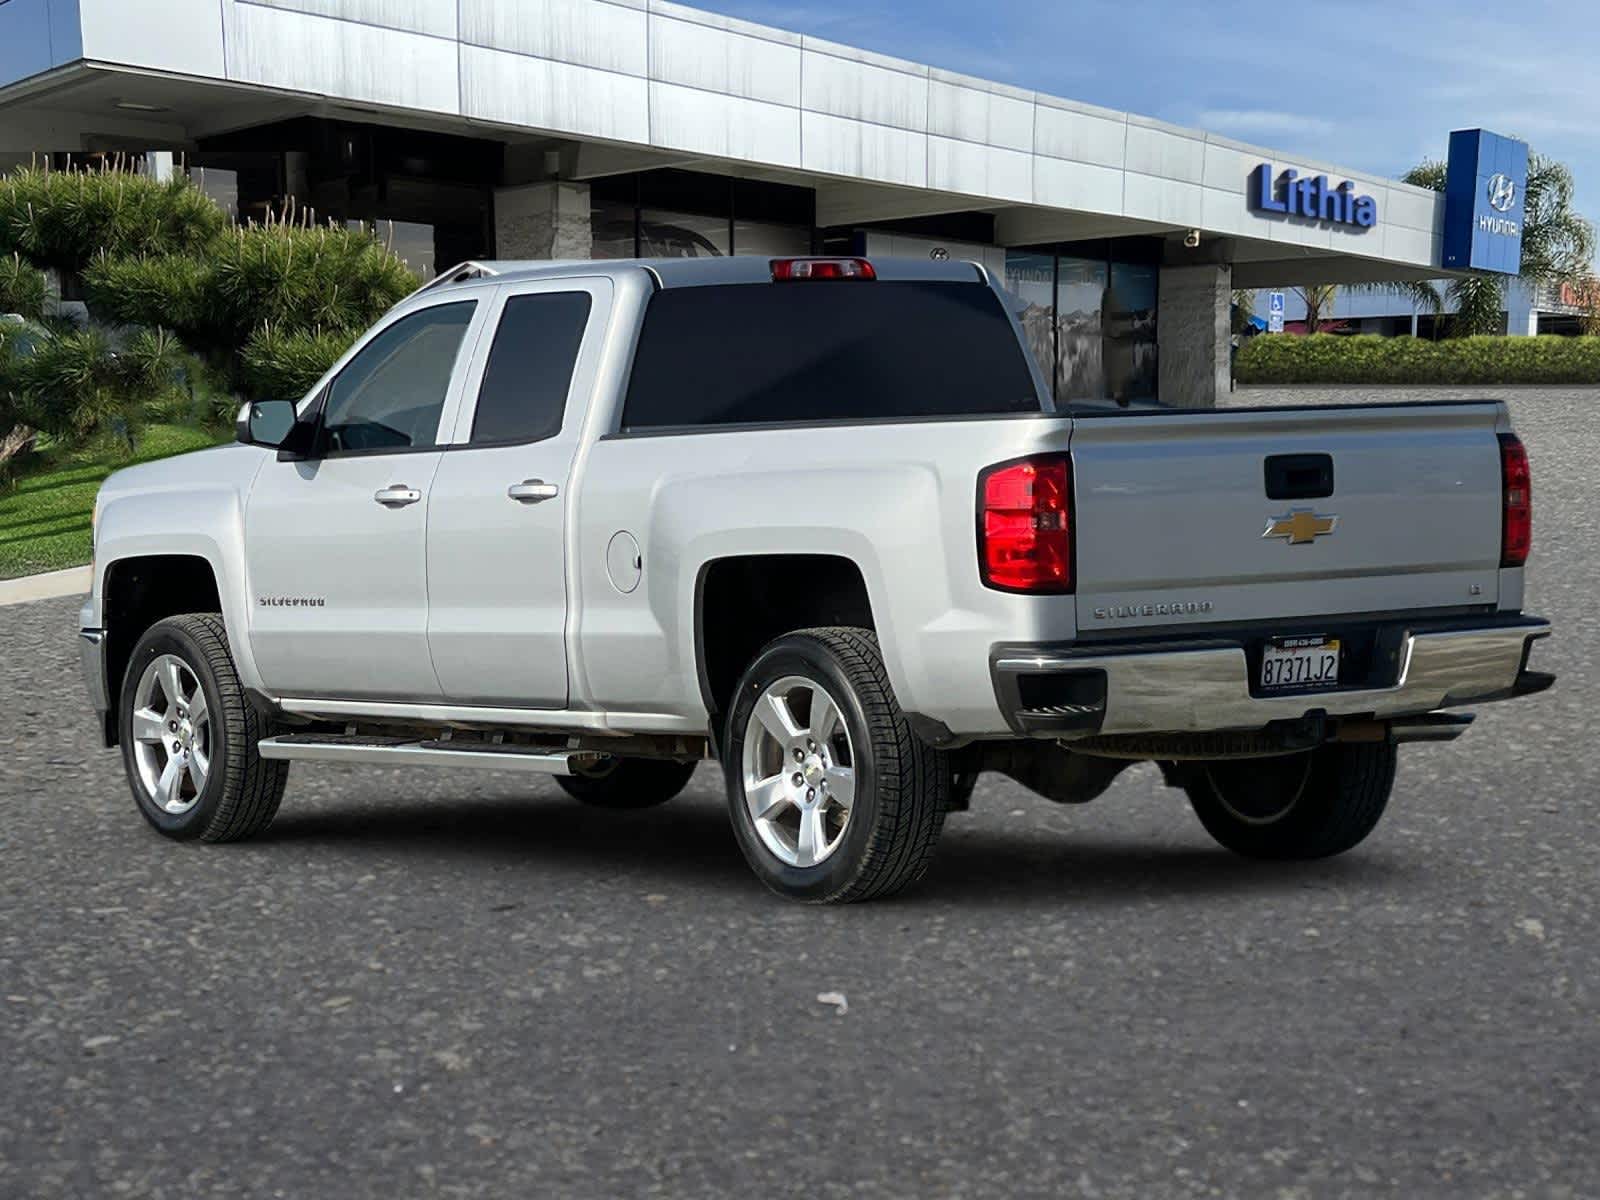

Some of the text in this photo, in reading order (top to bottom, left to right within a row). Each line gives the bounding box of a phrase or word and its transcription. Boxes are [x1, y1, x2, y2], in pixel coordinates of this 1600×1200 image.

[1254, 163, 1377, 228] Lithia
[1094, 601, 1214, 619] SILVERADO
[1263, 655, 1336, 684] 87371J2
